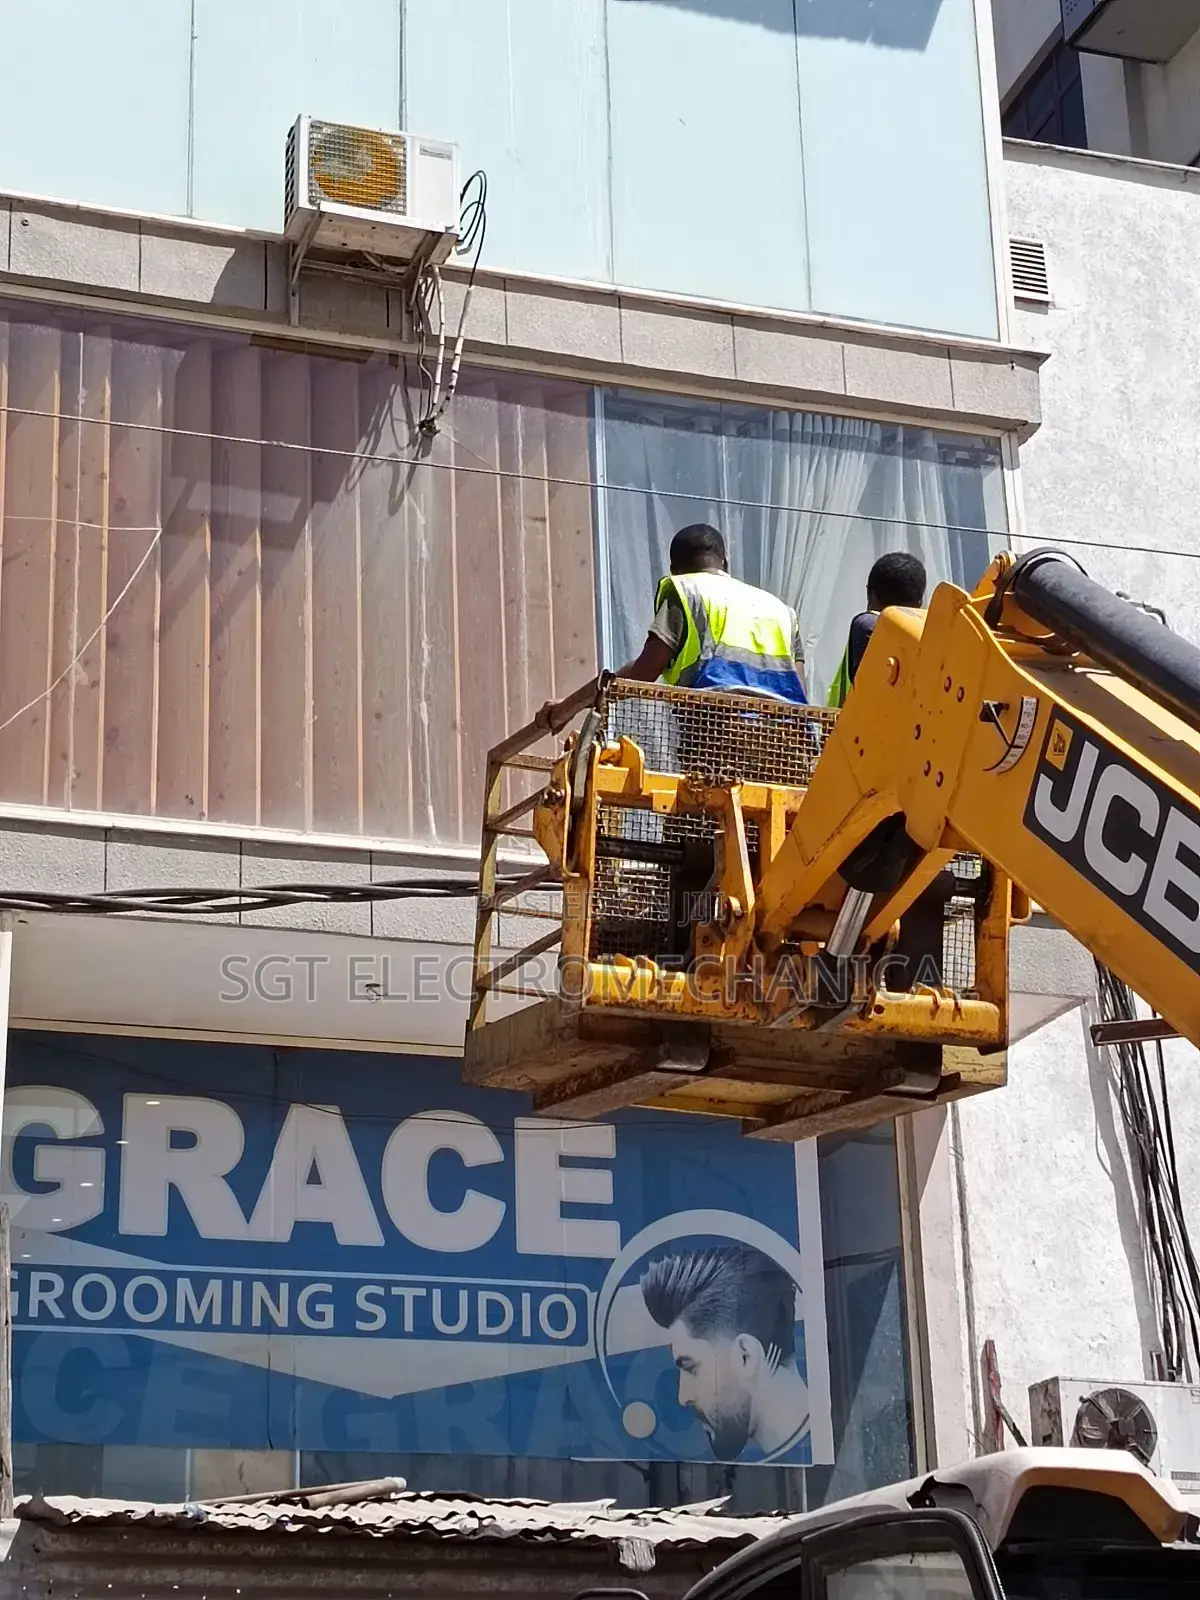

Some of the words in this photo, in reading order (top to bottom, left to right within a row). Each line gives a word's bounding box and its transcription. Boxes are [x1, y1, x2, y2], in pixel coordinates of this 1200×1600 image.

[1034, 740, 1200, 954] JCB
[2, 1085, 621, 1259] GRACE
[355, 1284, 577, 1340] STUDIO
